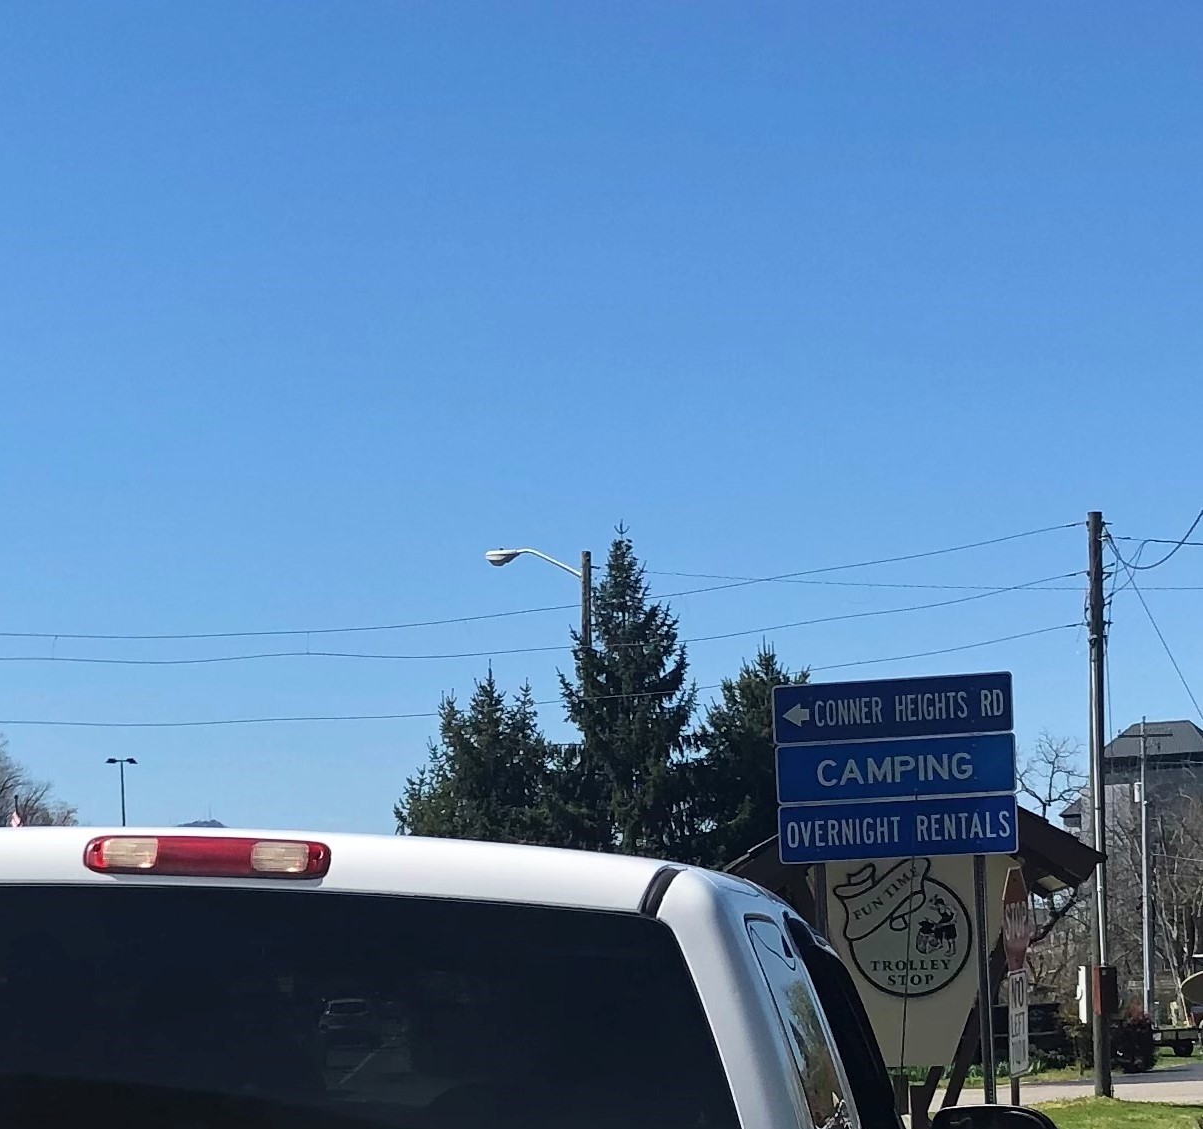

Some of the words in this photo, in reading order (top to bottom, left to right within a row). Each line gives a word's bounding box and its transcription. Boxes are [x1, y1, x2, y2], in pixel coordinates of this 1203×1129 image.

[814, 696, 883, 727] CONNER
[895, 691, 968, 722] HEIGHTS
[980, 689, 1004, 717] RD
[817, 752, 974, 787] CAMPING
[786, 816, 901, 848] OVERNIGHT
[916, 810, 1011, 842] RENTALS
[853, 897, 884, 920] FUN
[870, 959, 951, 972] TROLLEY
[887, 974, 934, 986] STOP
